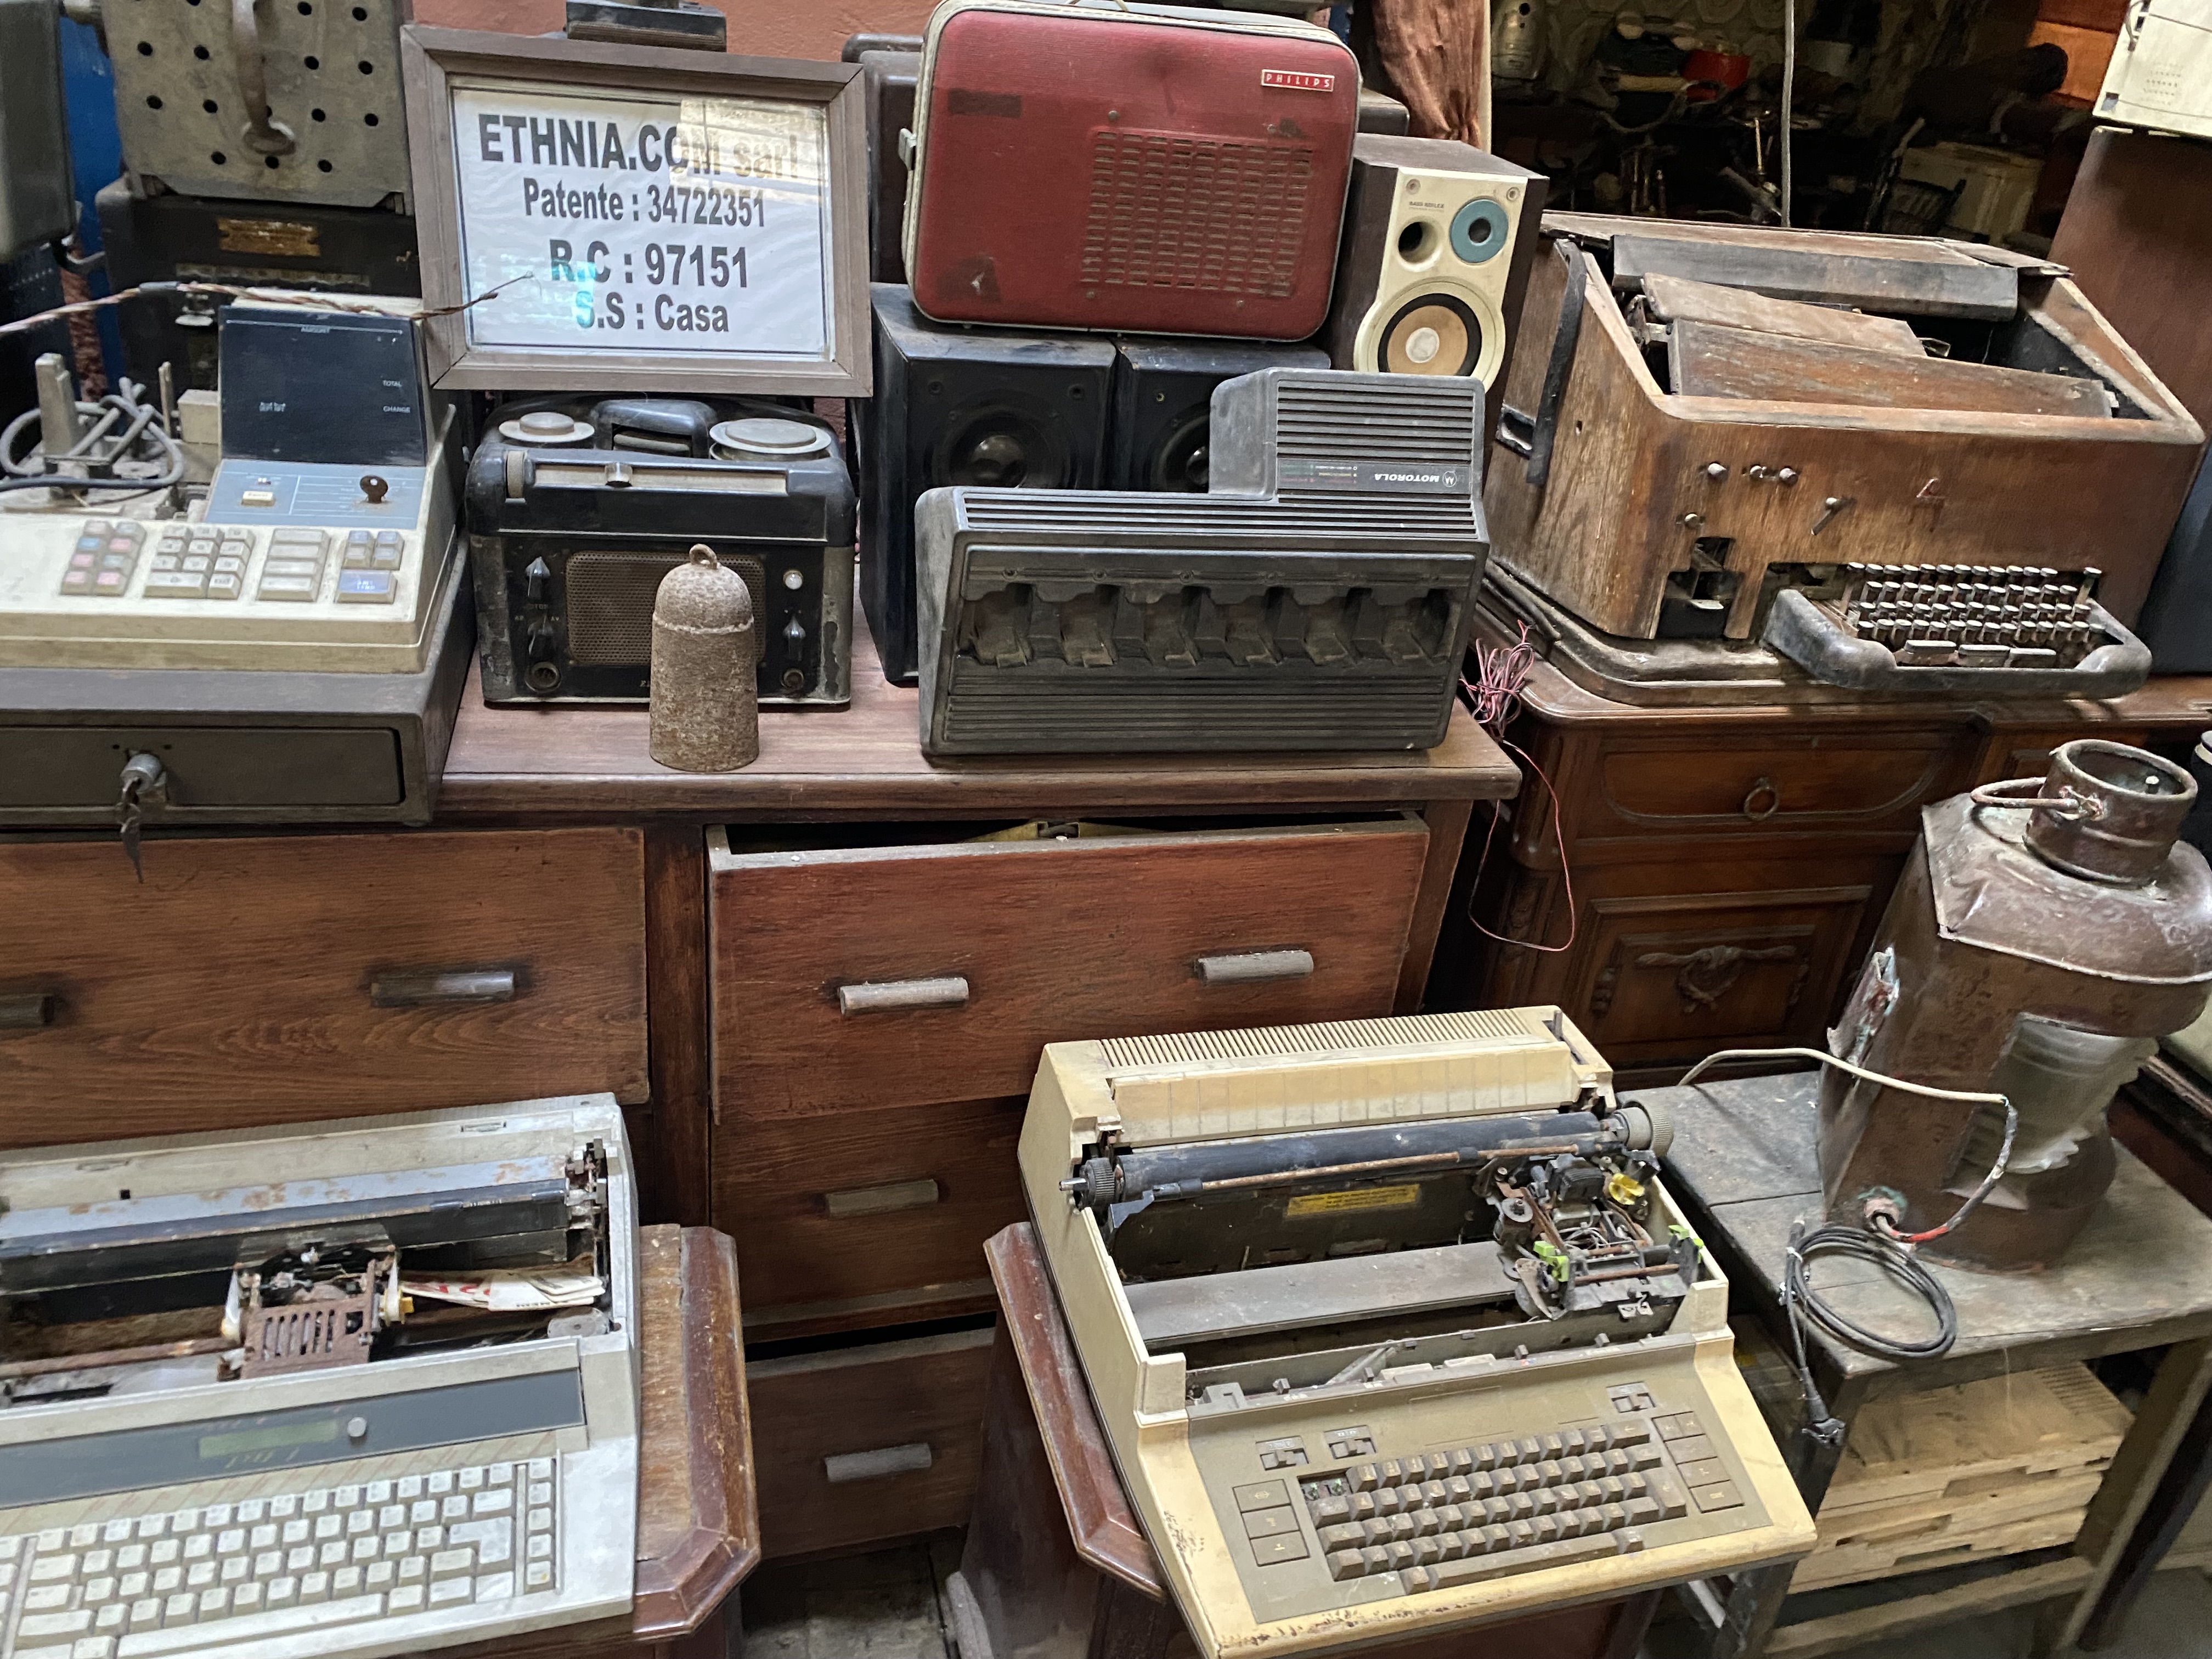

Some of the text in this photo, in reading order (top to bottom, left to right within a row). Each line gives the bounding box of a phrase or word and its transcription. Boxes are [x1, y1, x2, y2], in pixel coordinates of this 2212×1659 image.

[1266, 73, 1330, 88] PHILIPS
[478, 113, 721, 175] ETHNIA.COM
[523, 178, 765, 228] Patente : 34722351
[549, 239, 747, 289] R.C : 97151
[636, 303, 644, 330] :
[654, 294, 729, 332] Casa
[1374, 473, 1440, 483] MOTOROLA
